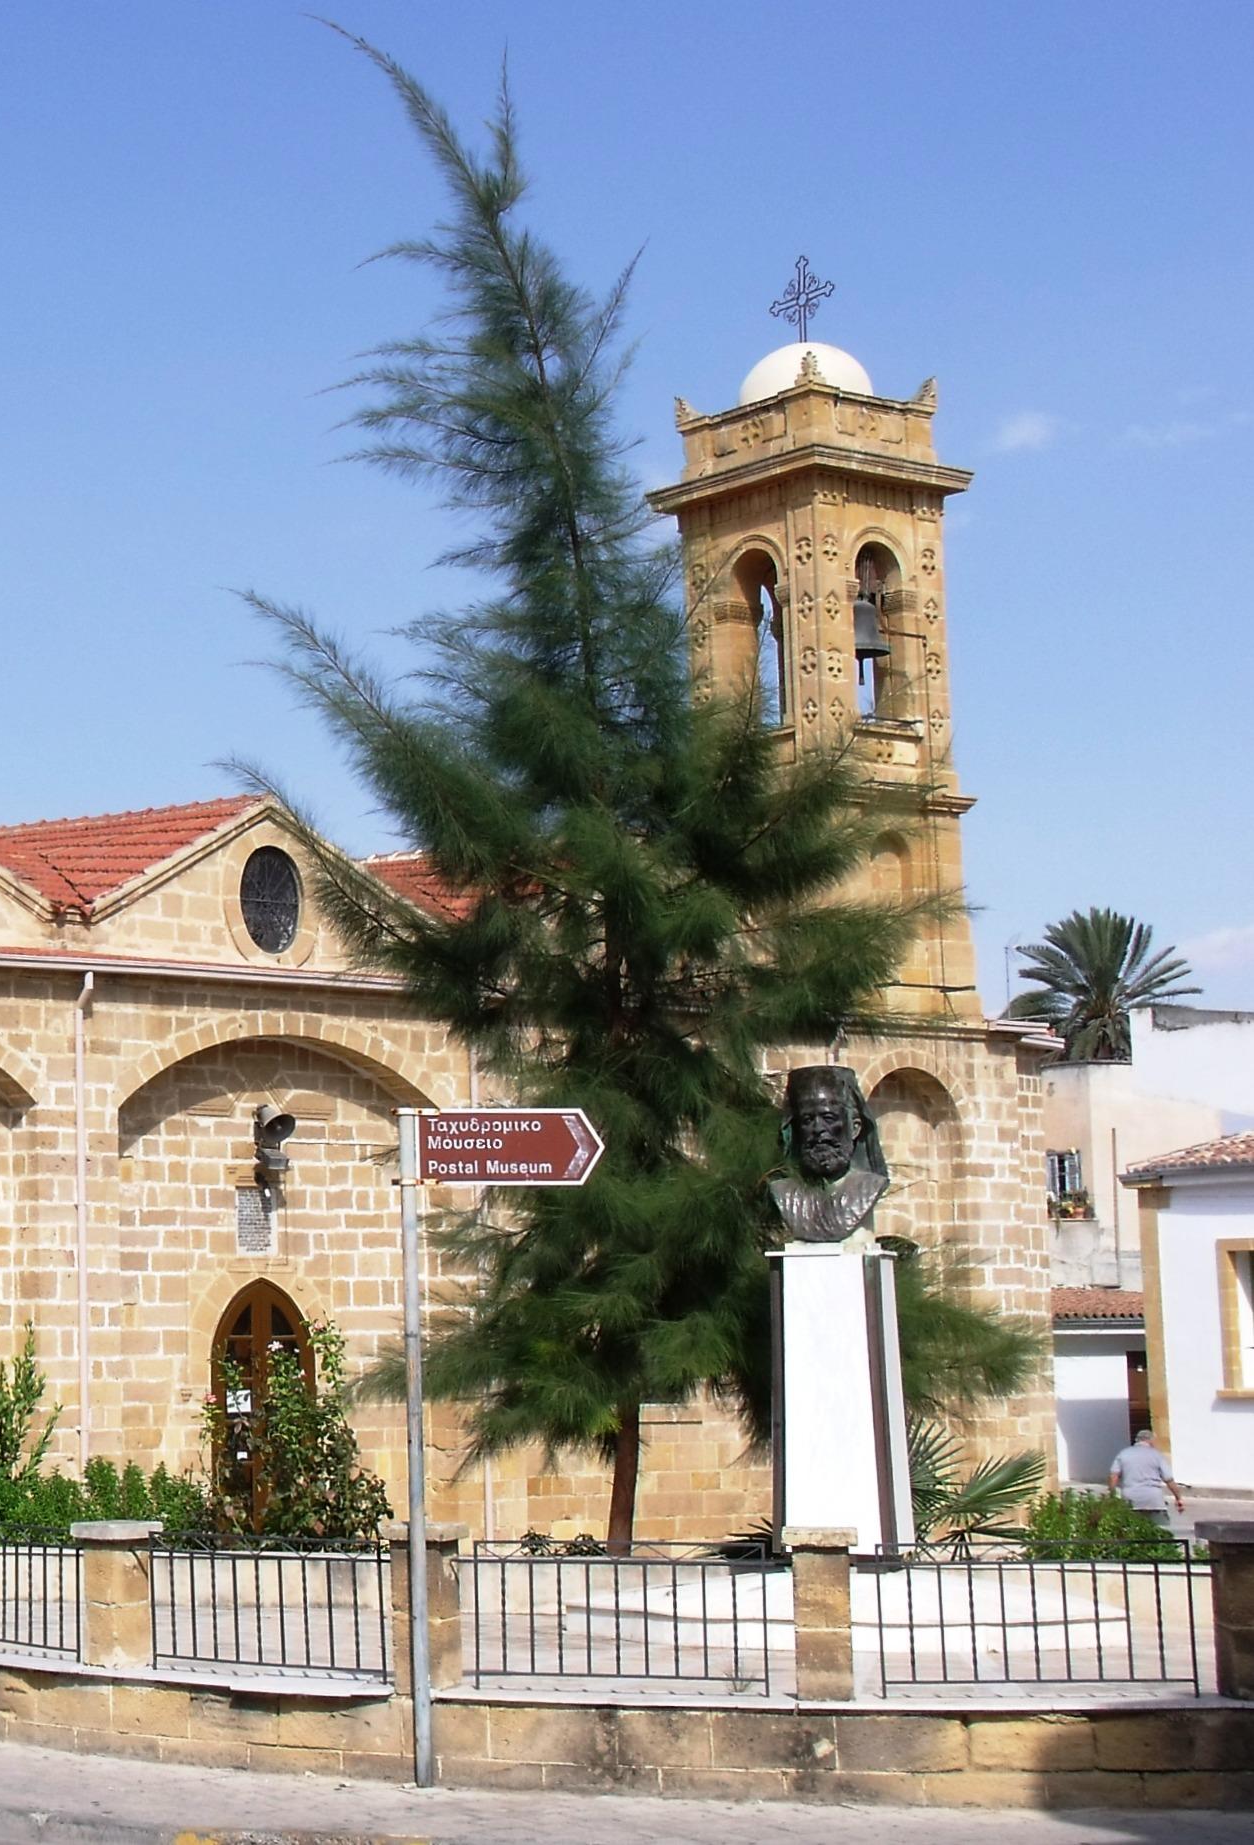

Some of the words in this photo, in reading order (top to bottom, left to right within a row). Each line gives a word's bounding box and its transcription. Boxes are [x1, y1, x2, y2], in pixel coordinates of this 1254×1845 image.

[427, 1118, 541, 1134] Ταχυδρομικο
[427, 1135, 503, 1149] Μουσειο
[428, 1160, 478, 1174] Postal
[486, 1160, 552, 1174] Museum
